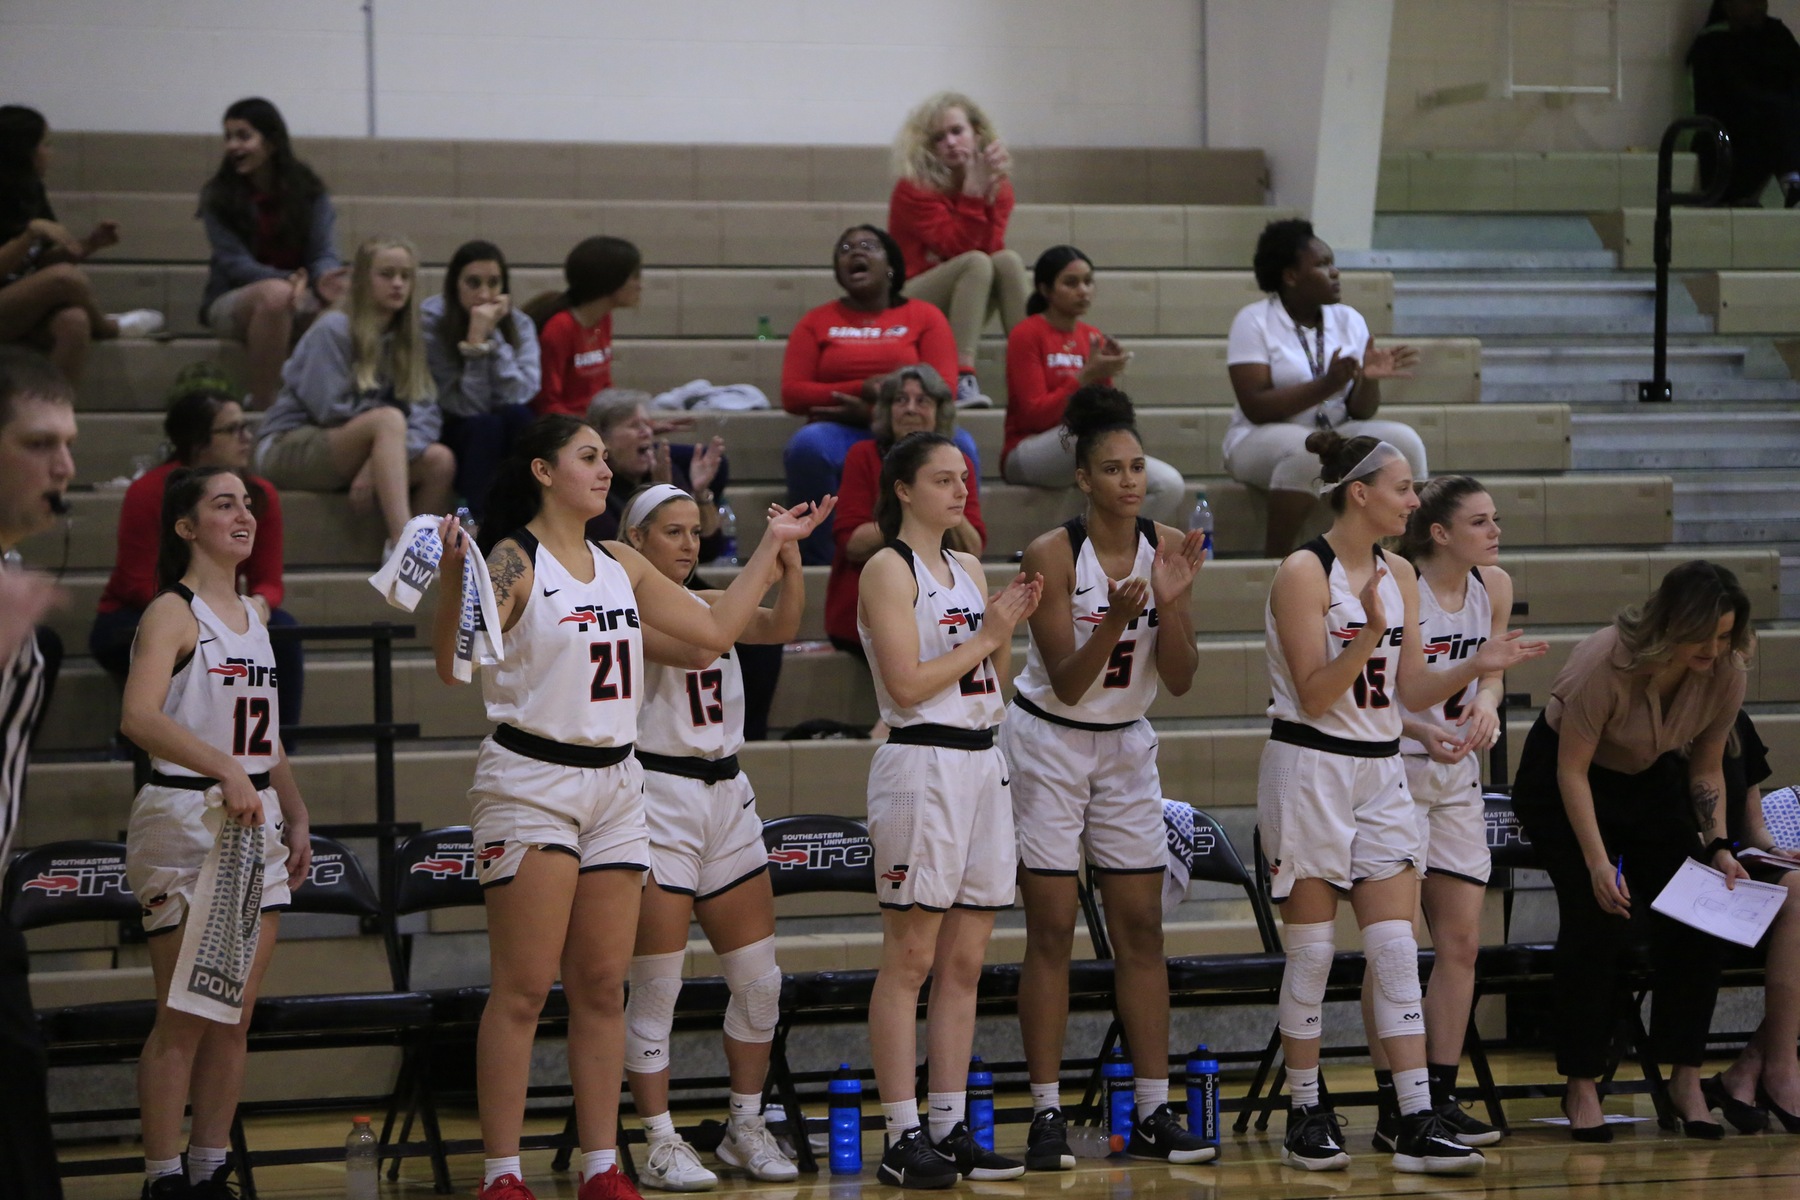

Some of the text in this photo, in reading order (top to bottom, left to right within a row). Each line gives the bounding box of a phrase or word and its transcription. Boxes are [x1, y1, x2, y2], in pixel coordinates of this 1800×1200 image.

[558, 605, 640, 632] Fire
[207, 657, 278, 688] Fire
[589, 639, 632, 702] 21
[1103, 639, 1137, 689] 5
[686, 668, 724, 727] 13
[232, 697, 272, 756] 12
[782, 831, 844, 841] SOUTHEASTERN
[823, 836, 870, 846] UNIVERSITY
[51, 857, 121, 866] SOUTHEASTERN
[768, 842, 873, 870] Fire
